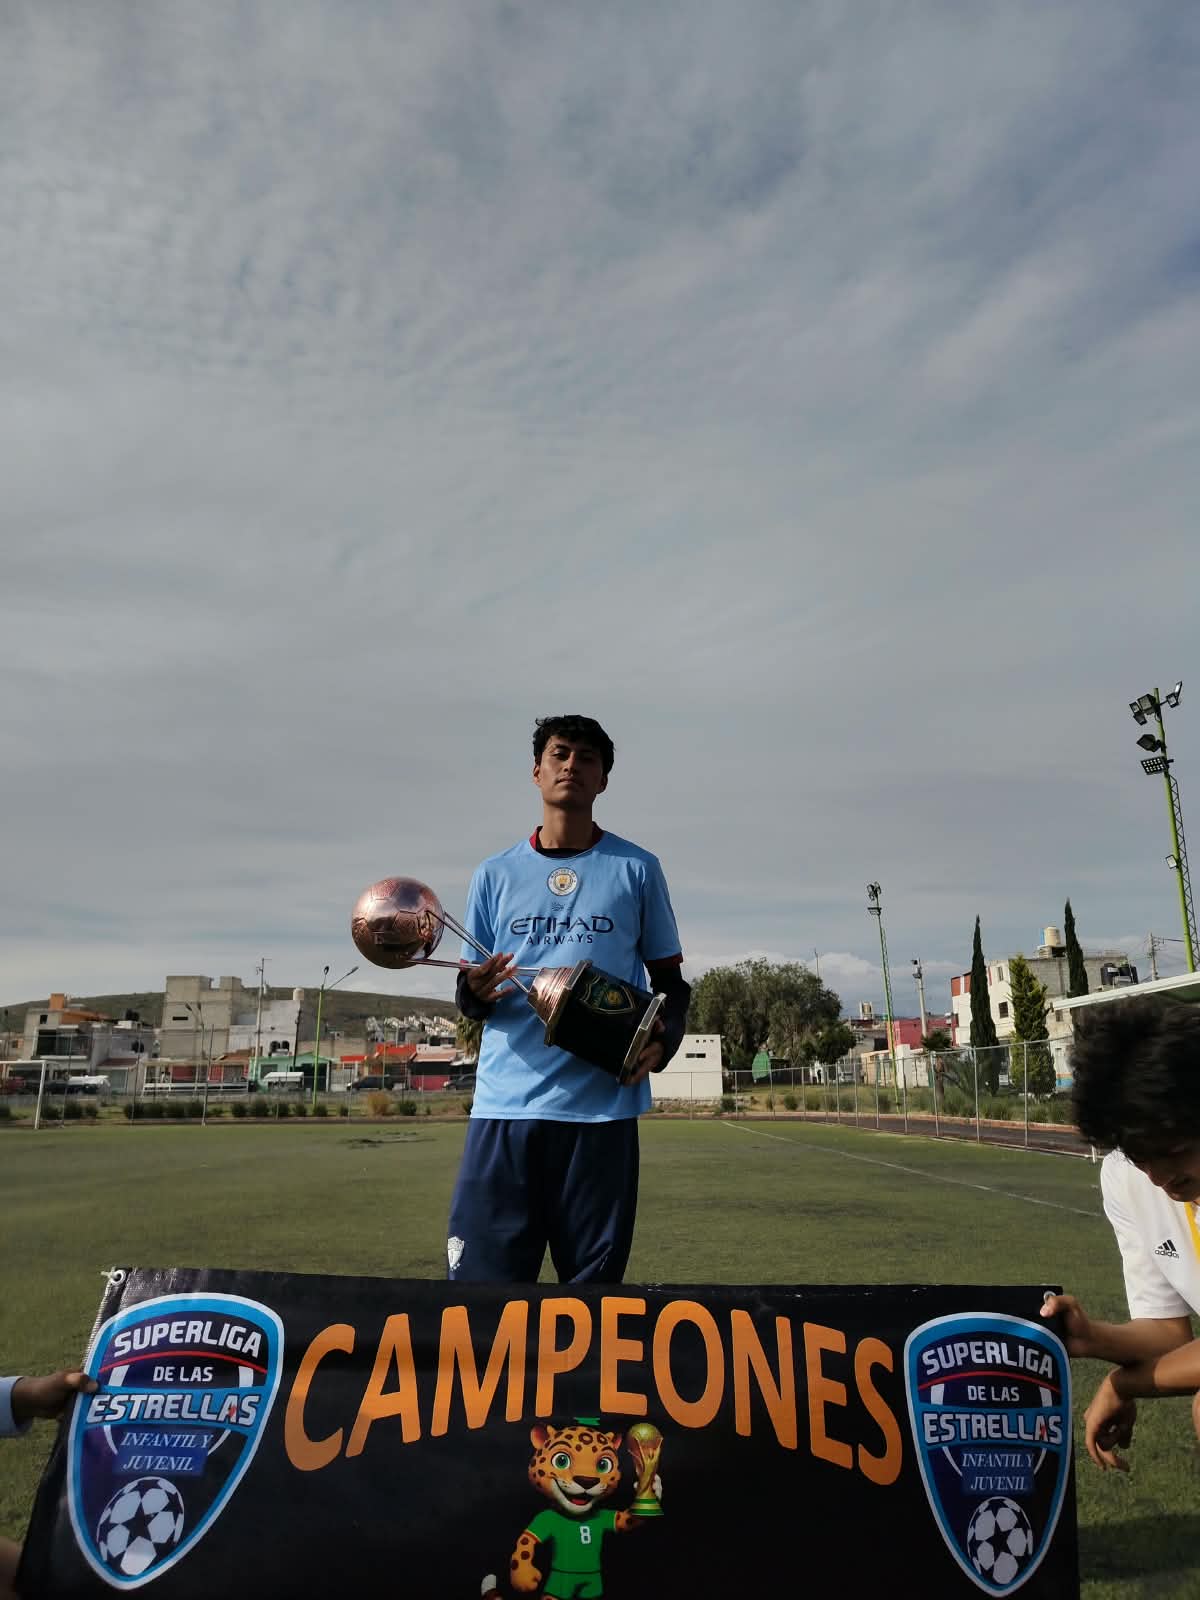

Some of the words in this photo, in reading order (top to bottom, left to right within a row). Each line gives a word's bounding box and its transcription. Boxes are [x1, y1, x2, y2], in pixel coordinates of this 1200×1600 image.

[510, 915, 614, 935] ETIHAD
[526, 934, 593, 945] AIRWAYS
[1155, 1250, 1179, 1259] adidas
[113, 1320, 263, 1358] SUPERLIGA
[922, 1341, 1053, 1378] SUPERLIGA
[152, 1366, 174, 1383] DE
[180, 1366, 213, 1383] LAS
[283, 1296, 903, 1486] CAMPEONES
[967, 1385, 986, 1401] DE
[991, 1386, 1020, 1402] LAS
[87, 1394, 259, 1424] ESTRELLAS
[923, 1412, 1062, 1445] ESTRELLAS
[121, 1433, 199, 1448] INFANTIL
[123, 1455, 194, 1472] JUVENIL
[970, 1476, 1026, 1491] JUVENIL
[579, 1525, 591, 1545] 8
